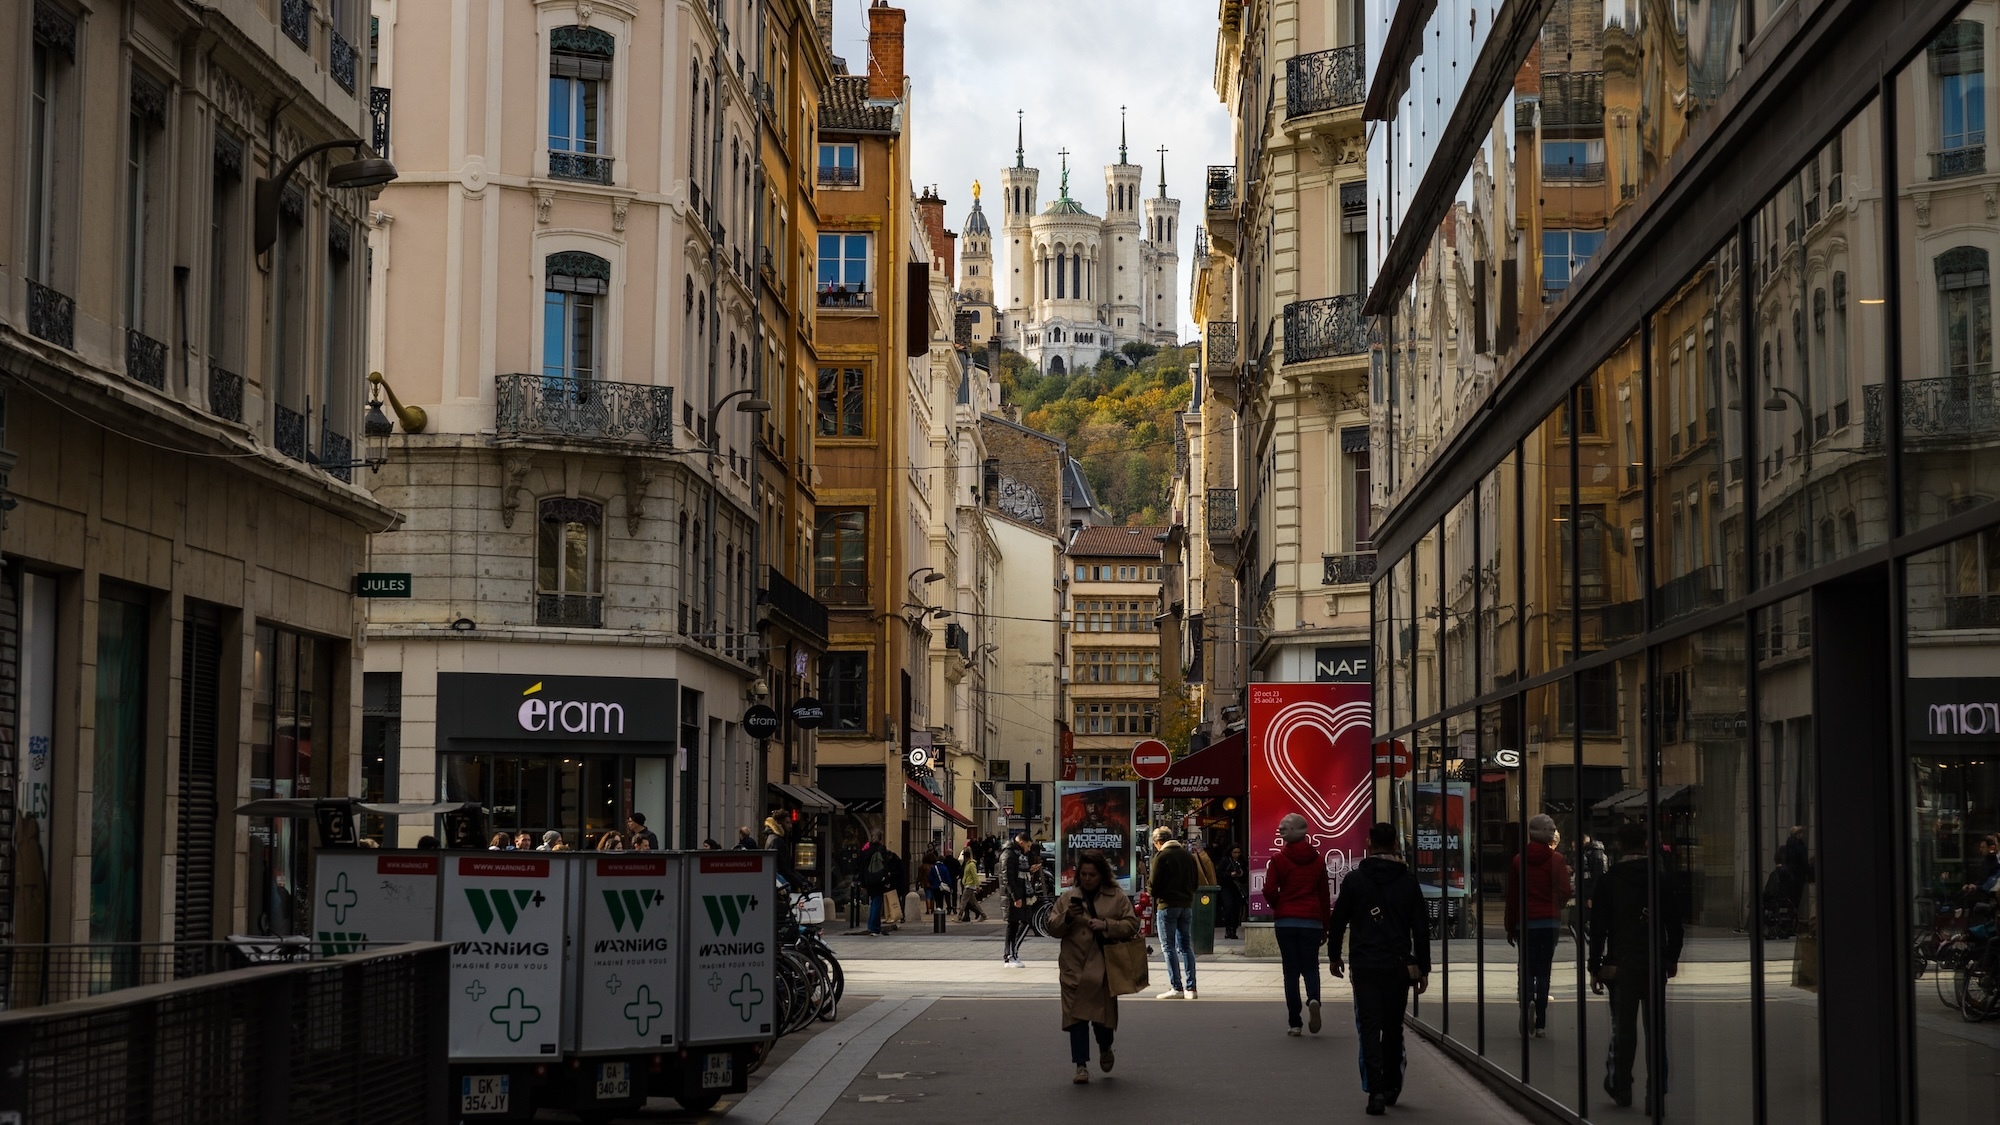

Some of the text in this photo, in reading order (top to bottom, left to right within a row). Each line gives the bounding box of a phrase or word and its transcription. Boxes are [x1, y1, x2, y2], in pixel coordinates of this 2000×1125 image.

[362, 579, 406, 591] JULES
[1317, 659, 1367, 676] NAF
[517, 681, 625, 734] éram
[749, 714, 777, 726] éram
[1163, 775, 1220, 786] Bouillon
[1173, 784, 1210, 792] maurice
[1068, 834, 1122, 842] MODERN
[1068, 841, 1122, 849] WARFARE
[473, 863, 536, 872] WWW.WARNING.FR
[452, 962, 490, 970] IMAGINÉ
[465, 1095, 506, 1111] 354-JY
